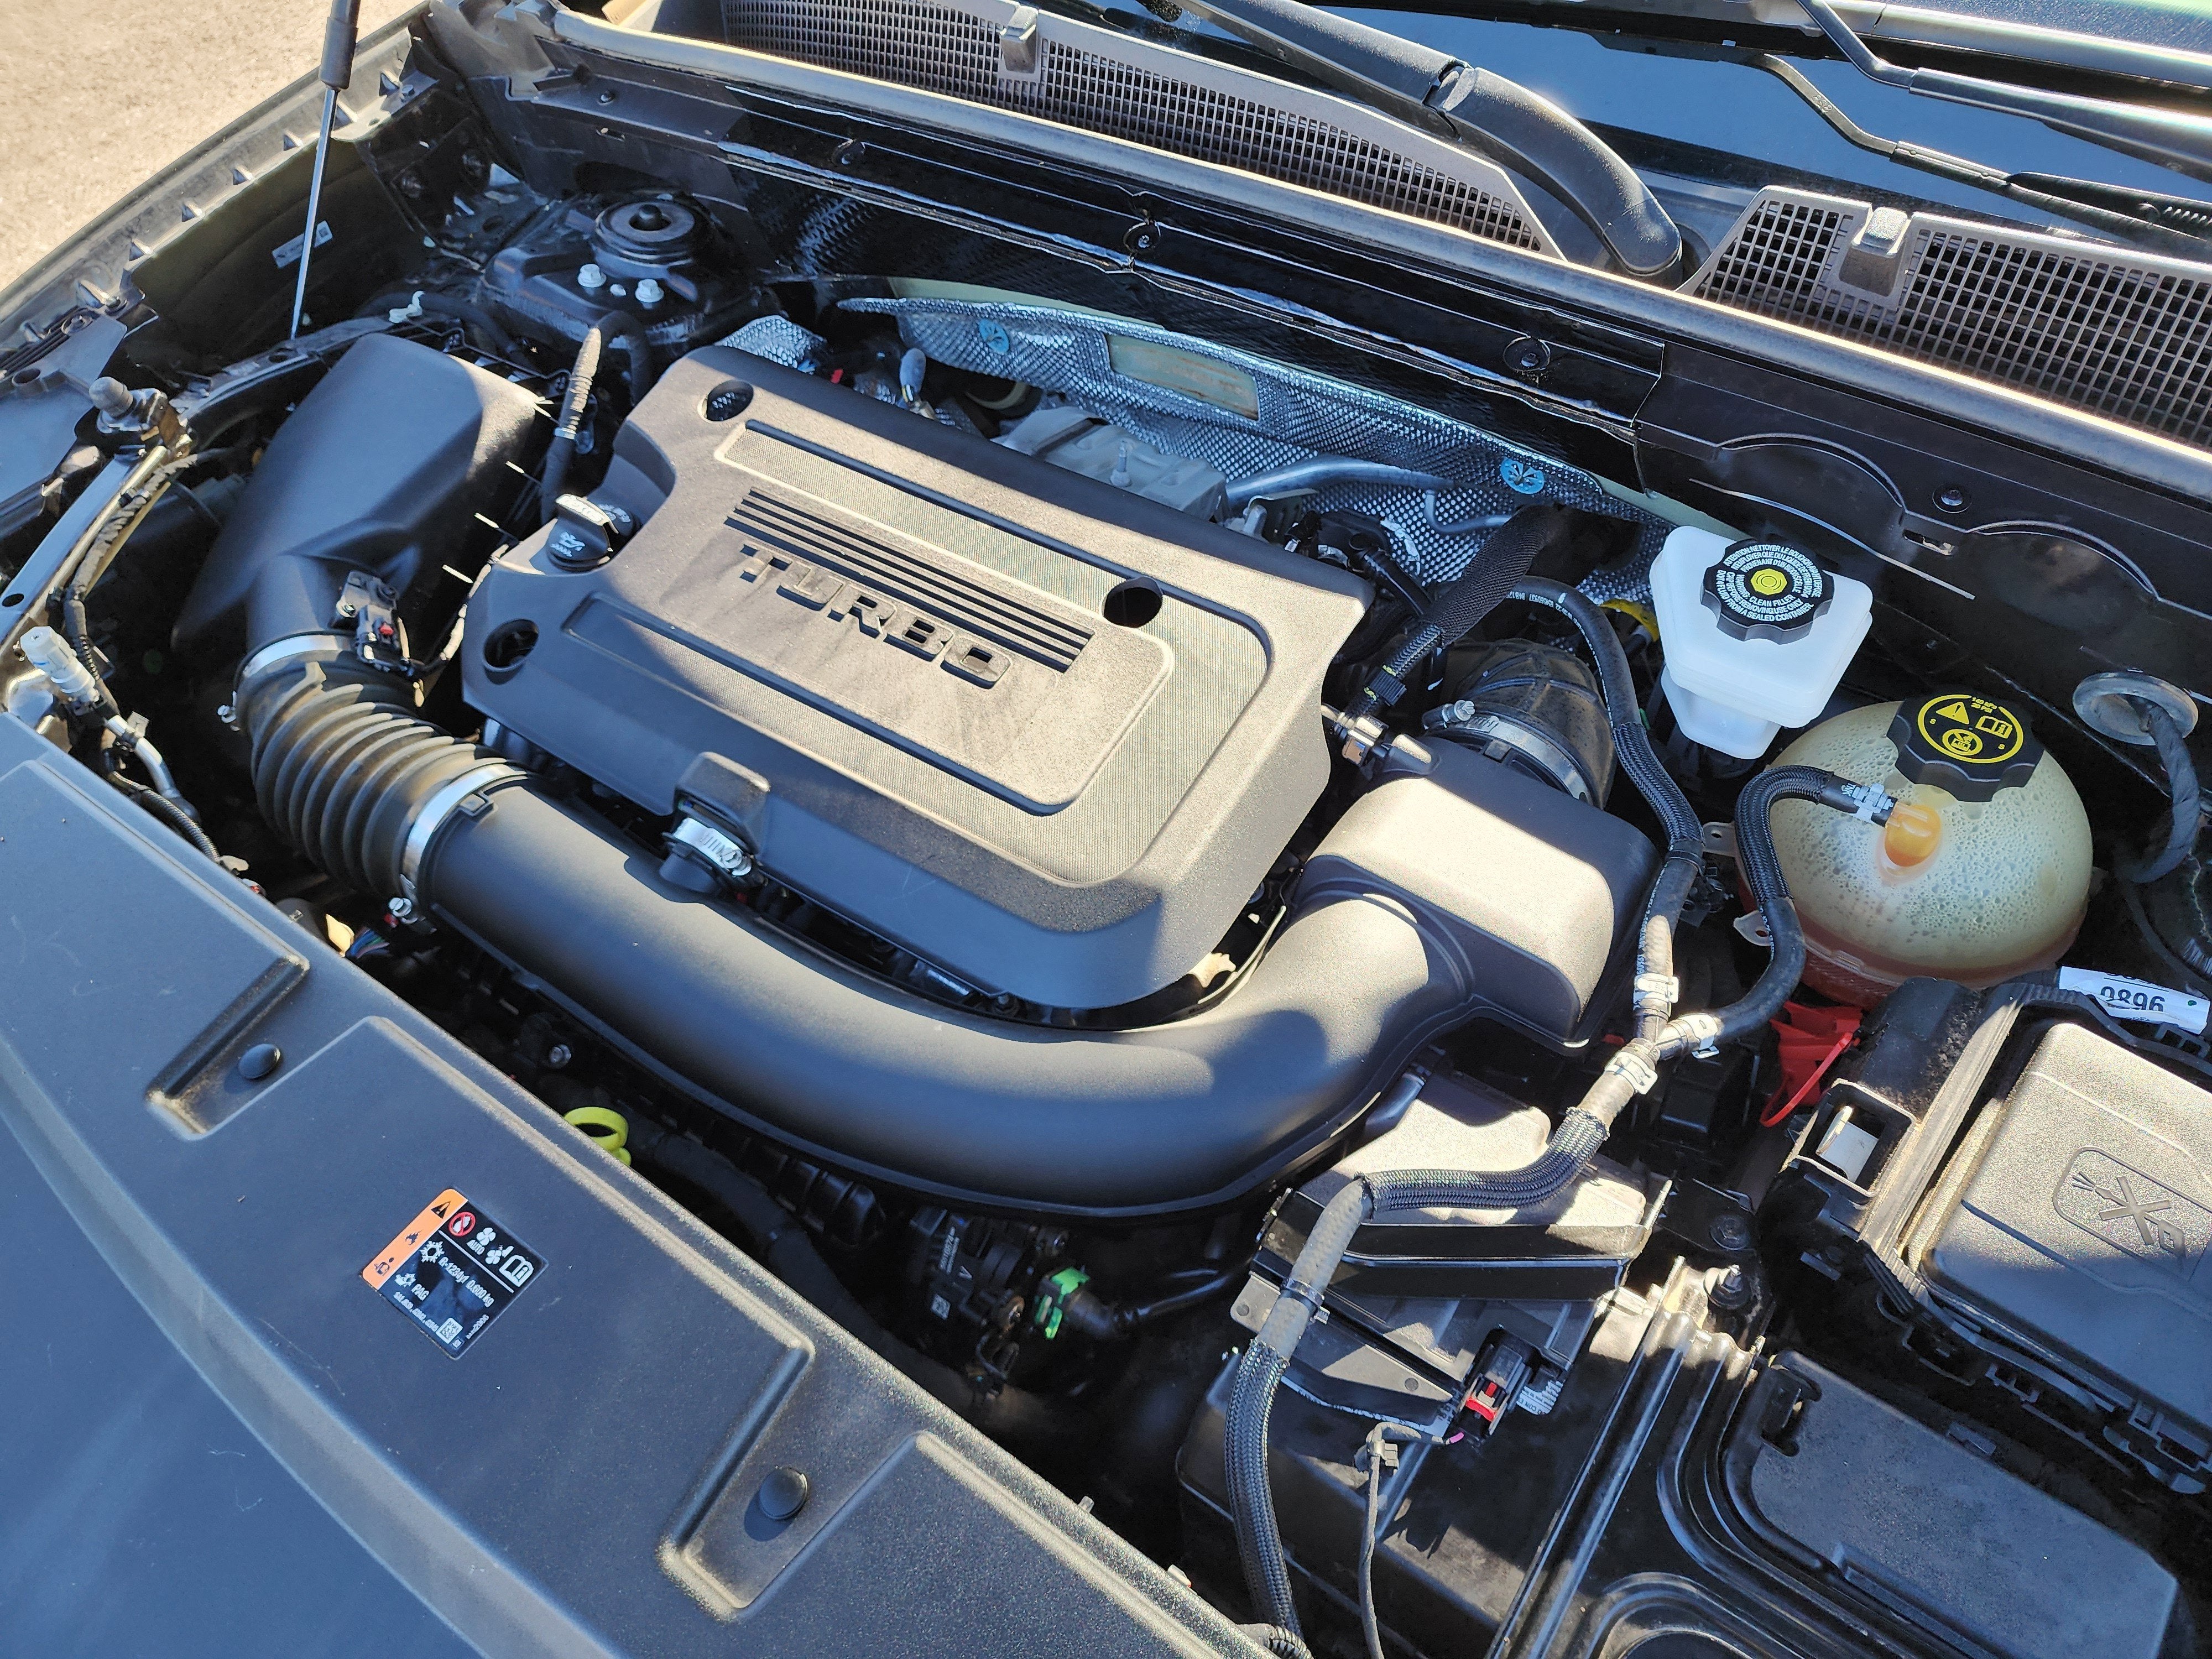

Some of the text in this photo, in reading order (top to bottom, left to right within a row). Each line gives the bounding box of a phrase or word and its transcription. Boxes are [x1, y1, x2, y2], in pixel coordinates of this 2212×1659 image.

[739, 542, 1011, 690] TURBO
[466, 1239, 485, 1255] AUTO
[410, 1282, 430, 1301] PAG
